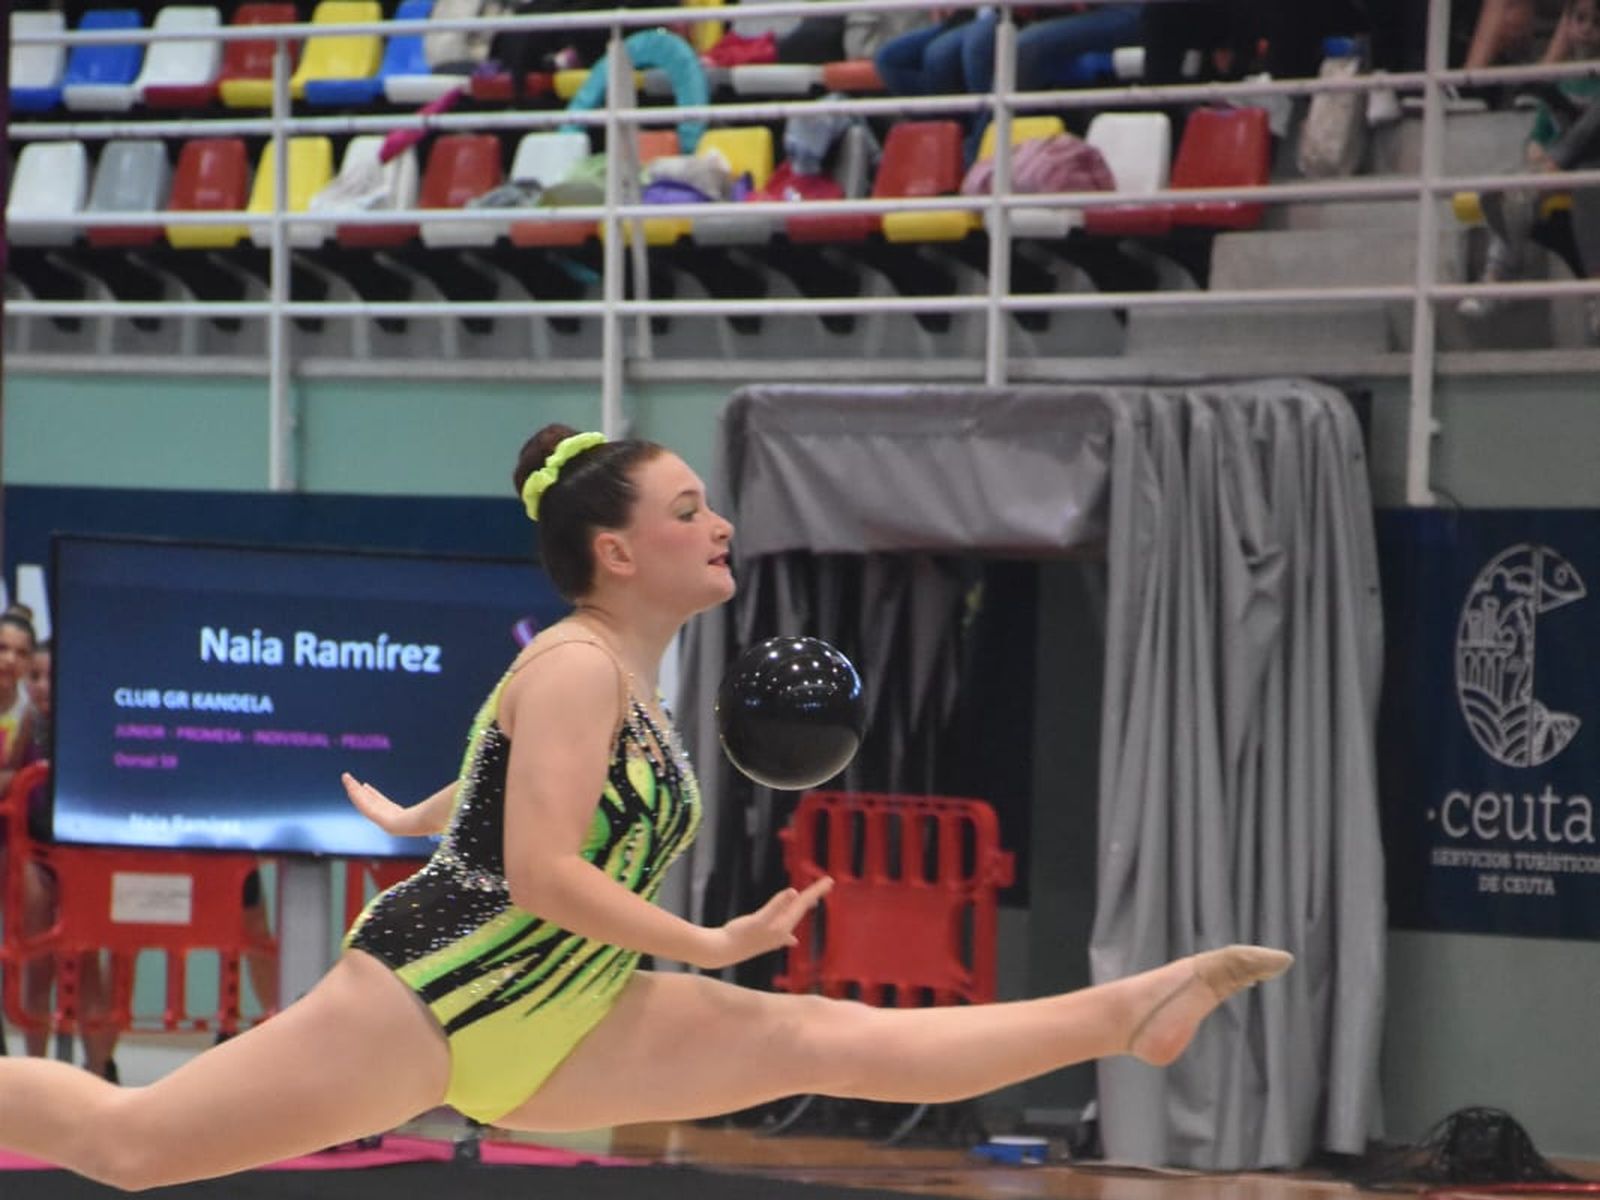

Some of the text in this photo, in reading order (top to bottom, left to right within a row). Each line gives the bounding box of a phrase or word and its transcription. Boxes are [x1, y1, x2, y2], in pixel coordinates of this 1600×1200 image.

[200, 627, 441, 673] Naia Ramírez
[114, 688, 160, 708] CLUB
[163, 691, 190, 709] GR
[1478, 875, 1500, 892] DE
